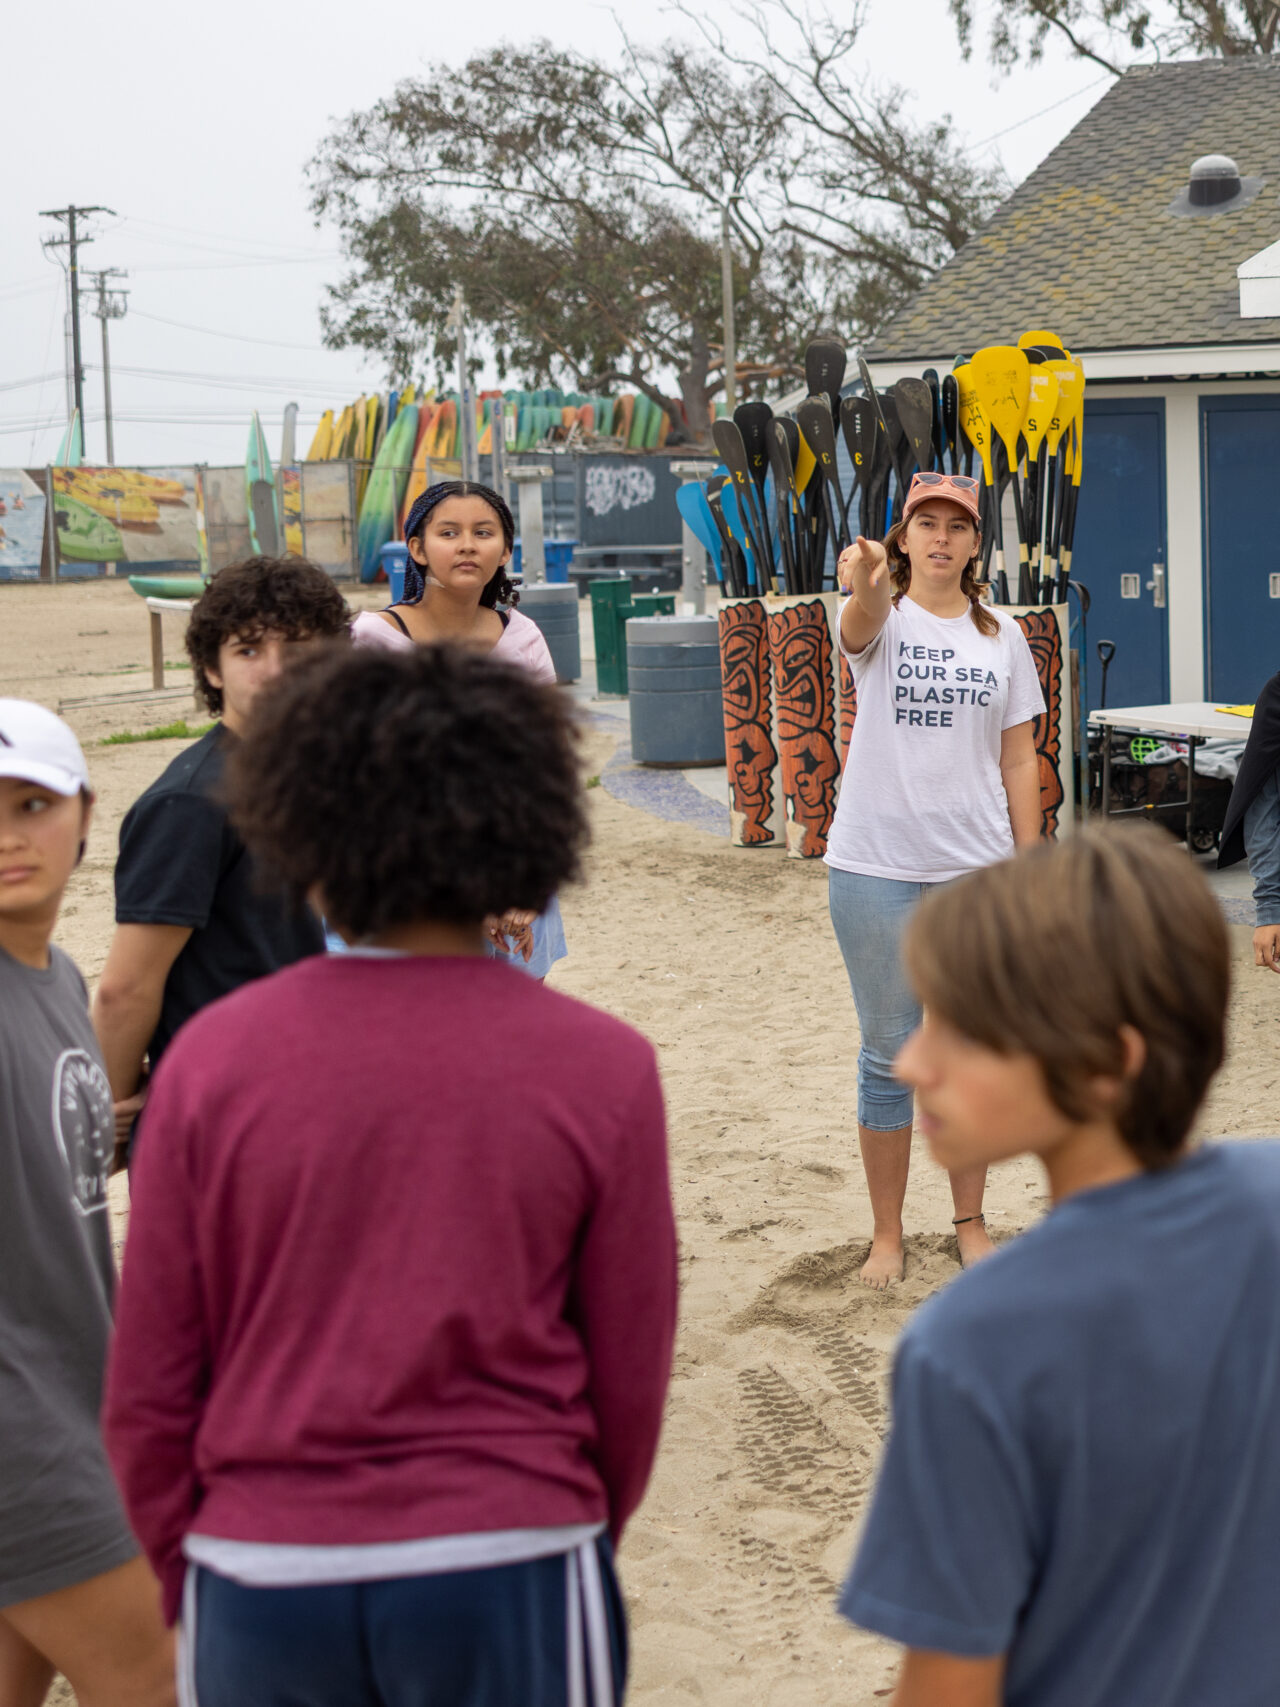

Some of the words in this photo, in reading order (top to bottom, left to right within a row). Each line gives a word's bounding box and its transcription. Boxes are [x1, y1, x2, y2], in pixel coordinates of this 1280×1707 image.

[1028, 418, 1037, 431] 5
[899, 641, 955, 662] KEEP
[897, 663, 947, 681] OUR
[955, 667, 998, 687] SEA
[895, 685, 992, 707] PLASTIC
[895, 708, 954, 728] FREE
